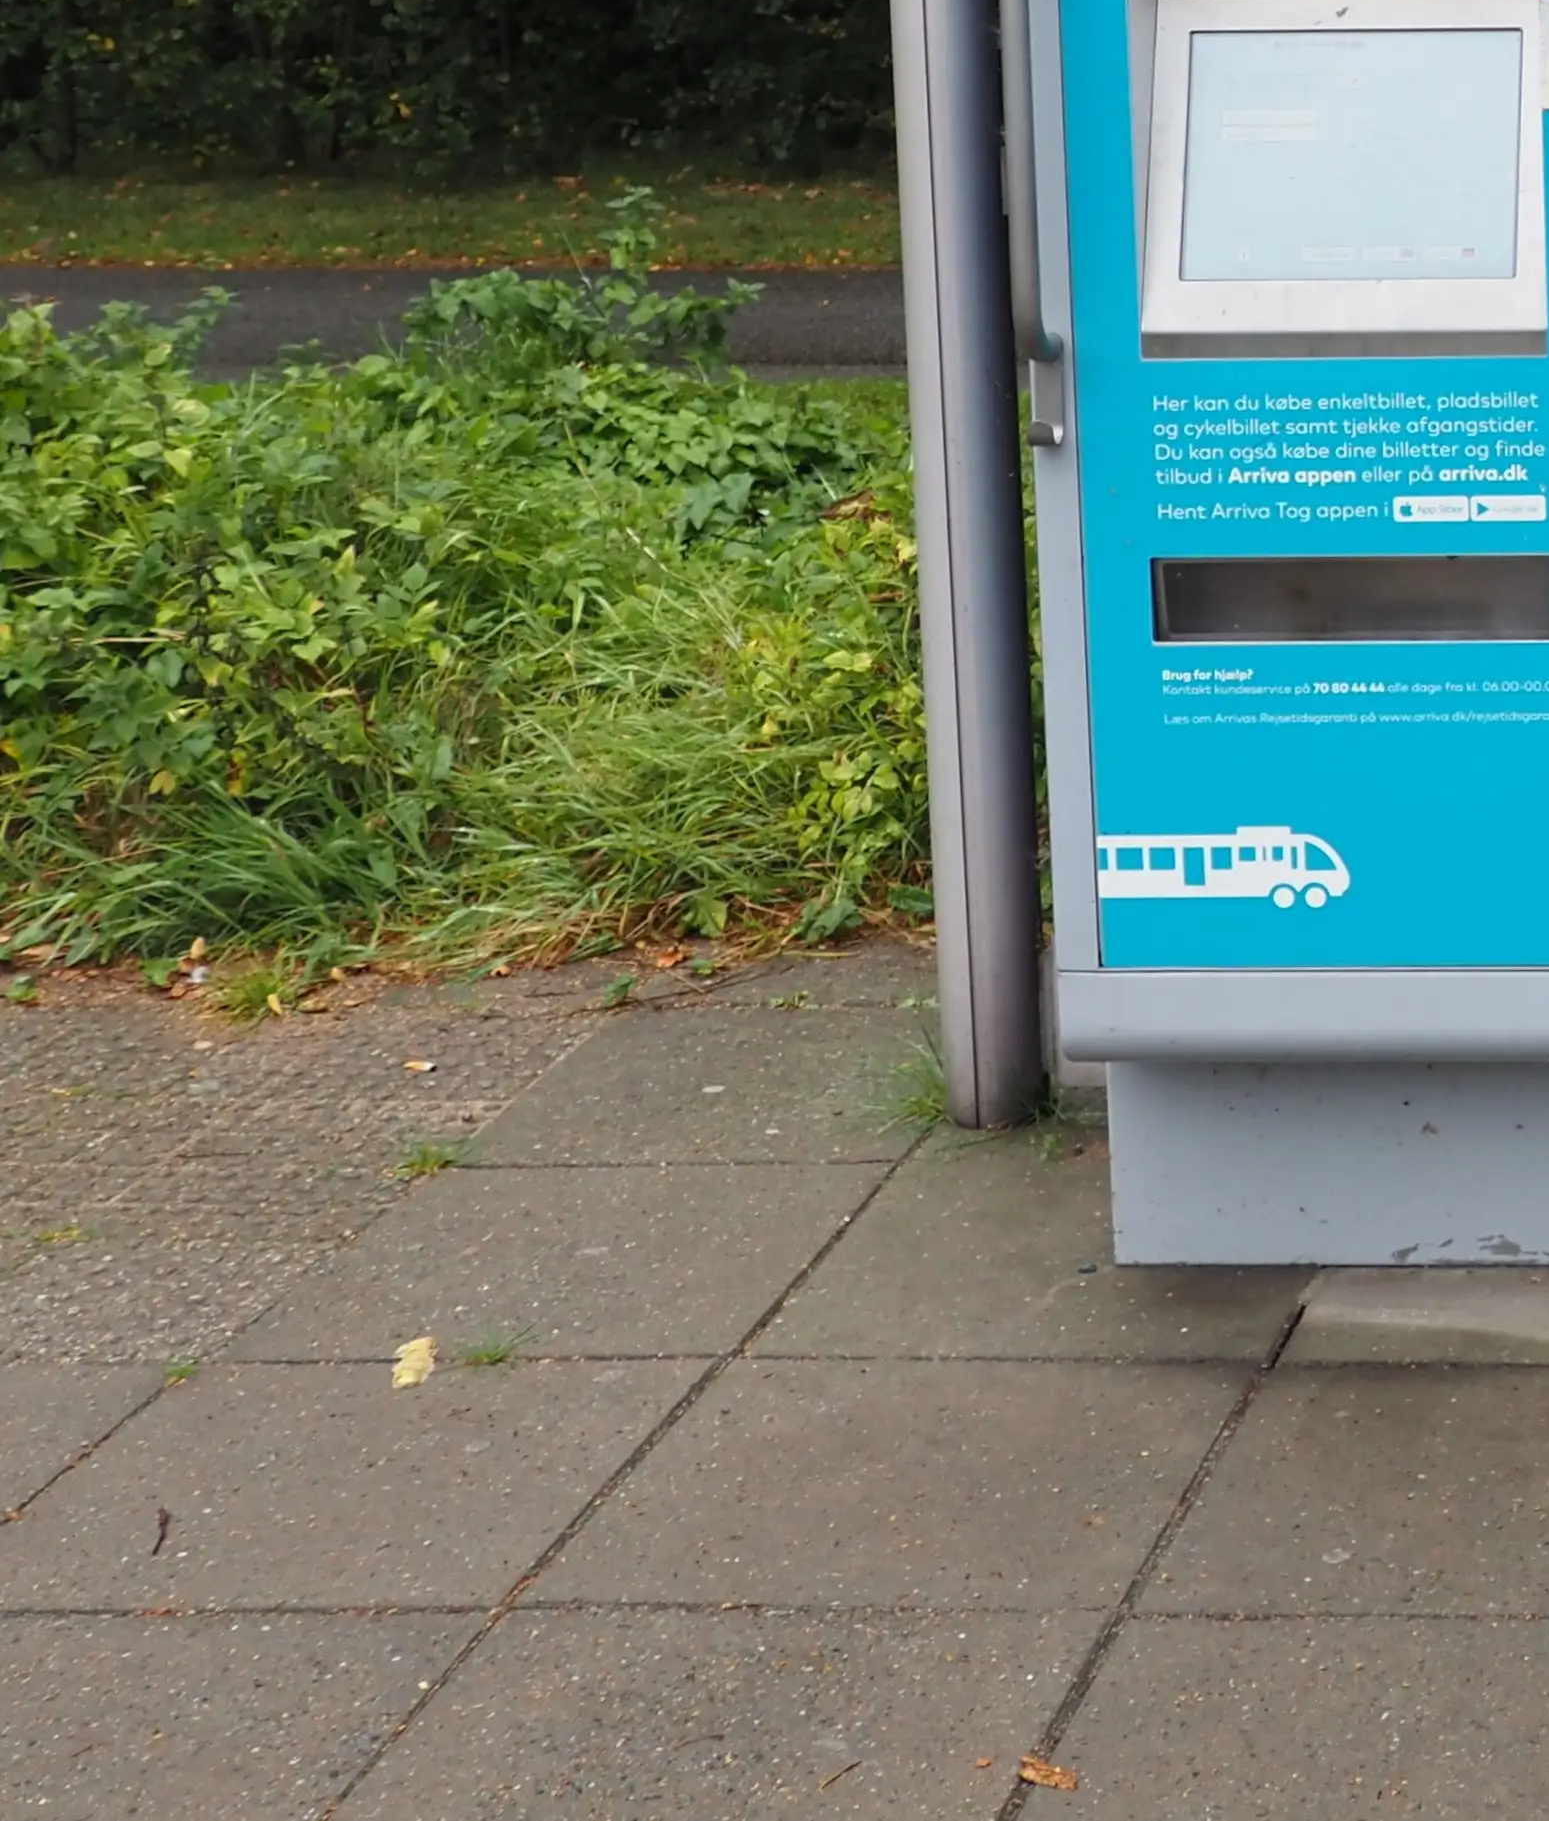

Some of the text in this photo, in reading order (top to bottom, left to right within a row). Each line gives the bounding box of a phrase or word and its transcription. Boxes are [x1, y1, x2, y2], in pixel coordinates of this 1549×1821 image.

[1152, 390, 1539, 412] Her kan du købe enkeltbillet, pladsbillet
[1152, 415, 1539, 440] og cykelbillet samt tjekke afgangstider.
[1154, 438, 1546, 463] Du kan også købe dine billetter og finde
[1154, 463, 1529, 487] tilbud i Arriva appen eller på arriva.dk
[1156, 501, 1389, 523] Hent Arriva Tog appen i
[1162, 668, 1254, 682] Brug for hjælp?
[1162, 684, 1211, 695] Kontakt
[1214, 684, 1292, 695] kundeservice
[1294, 682, 1311, 695] på
[1313, 683, 1329, 694] 70
[1331, 682, 1349, 694] 80
[1387, 682, 1409, 693] alle
[1411, 682, 1442, 695] dage
[1445, 681, 1463, 693] fra
[1164, 713, 1190, 725] Læs
[1192, 715, 1212, 724] om
[1215, 713, 1257, 724] Arrivas
[1360, 711, 1377, 724] på
